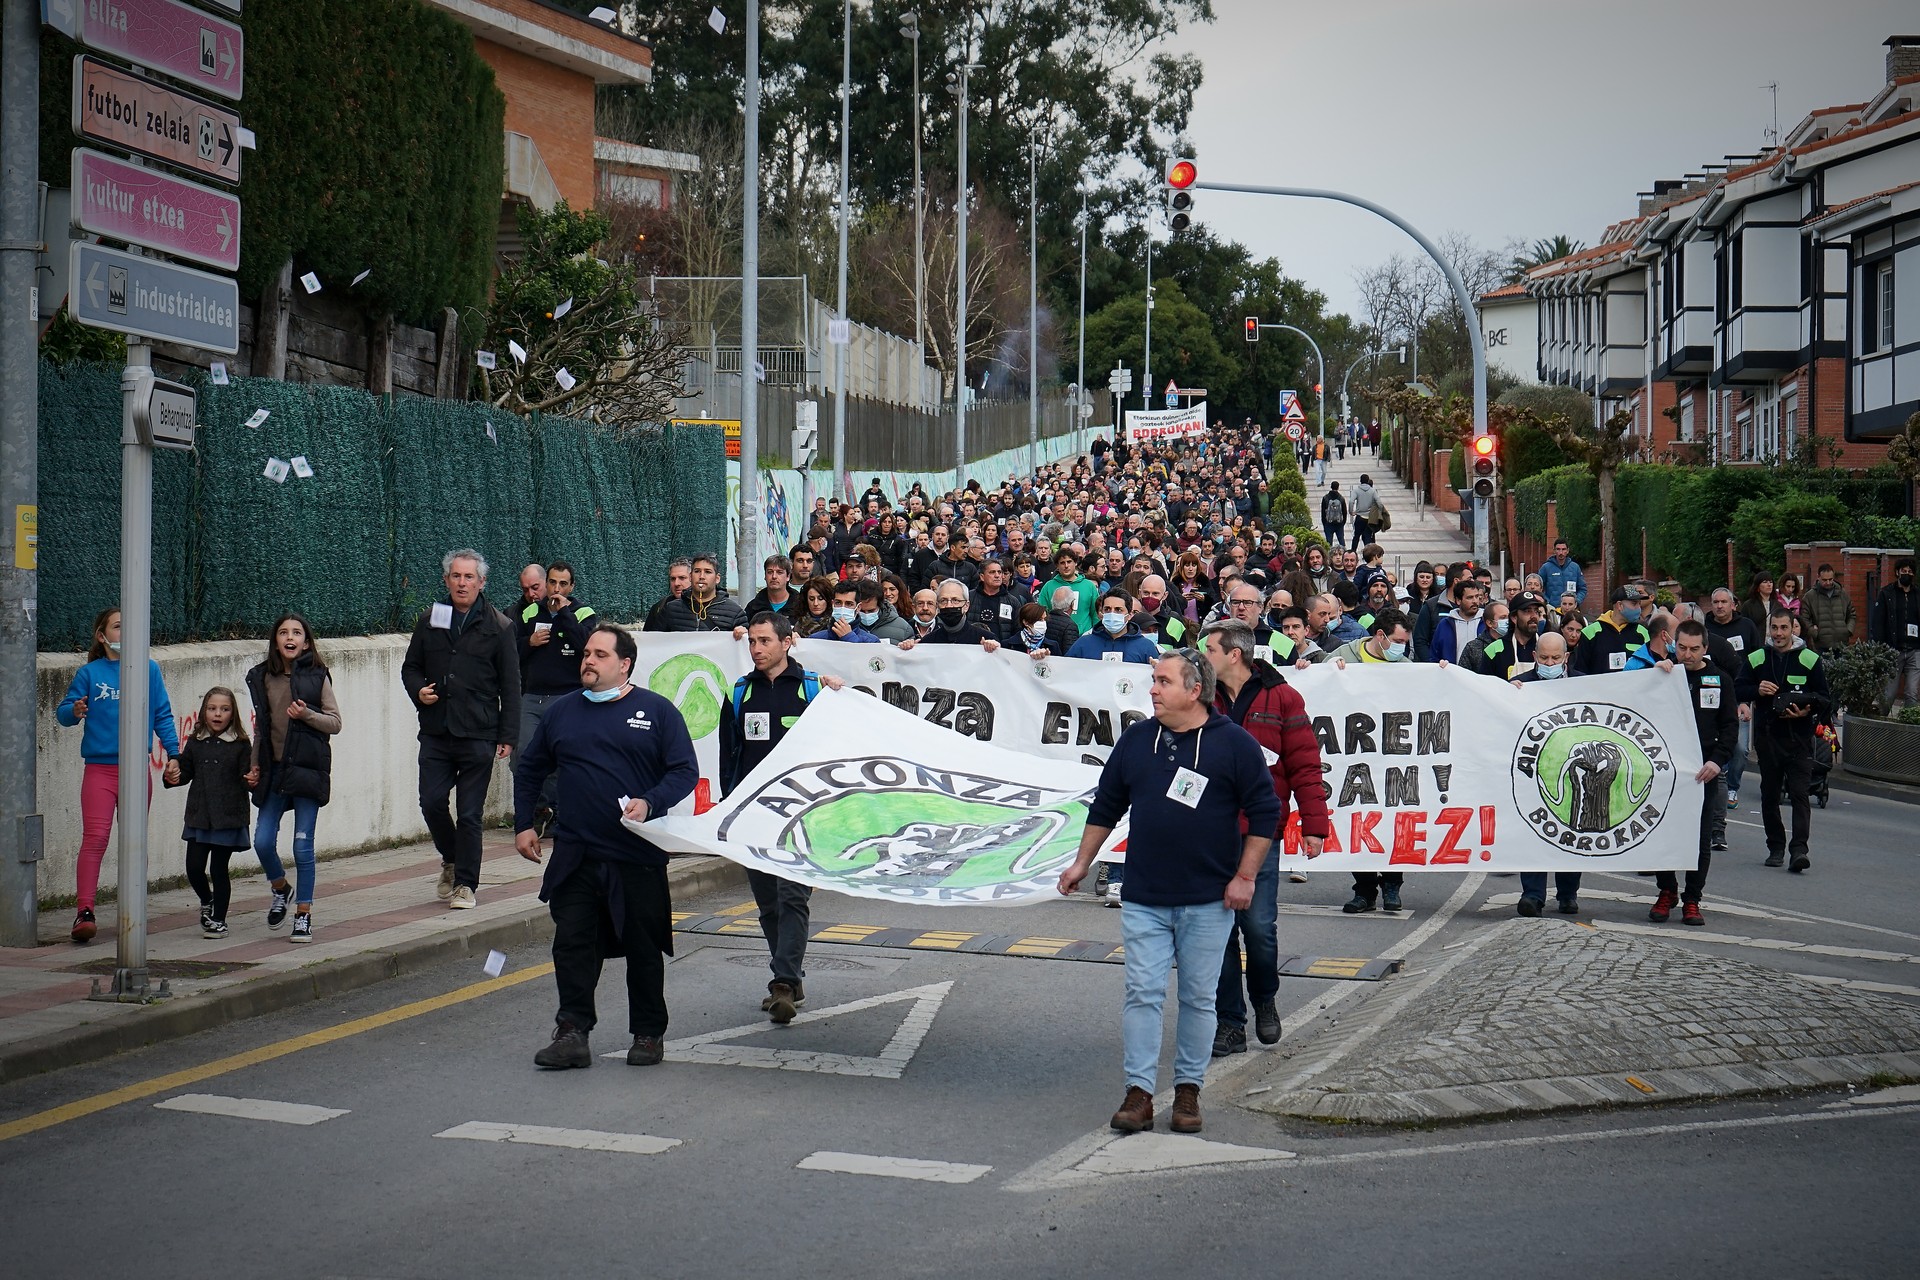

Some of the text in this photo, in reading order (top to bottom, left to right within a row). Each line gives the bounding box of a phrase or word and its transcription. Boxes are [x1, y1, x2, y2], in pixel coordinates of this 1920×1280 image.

[89, 0, 127, 33] eliza
[88, 83, 190, 145] futbol zelaia
[86, 174, 185, 231] kultur etxea
[135, 279, 233, 328] industrialdea
[160, 401, 192, 433] Behargintza
[1517, 705, 1669, 778] ALCONZA IRIZAR
[756, 759, 1042, 819] ALCONZA
[1528, 803, 1661, 851] BORROKAN
